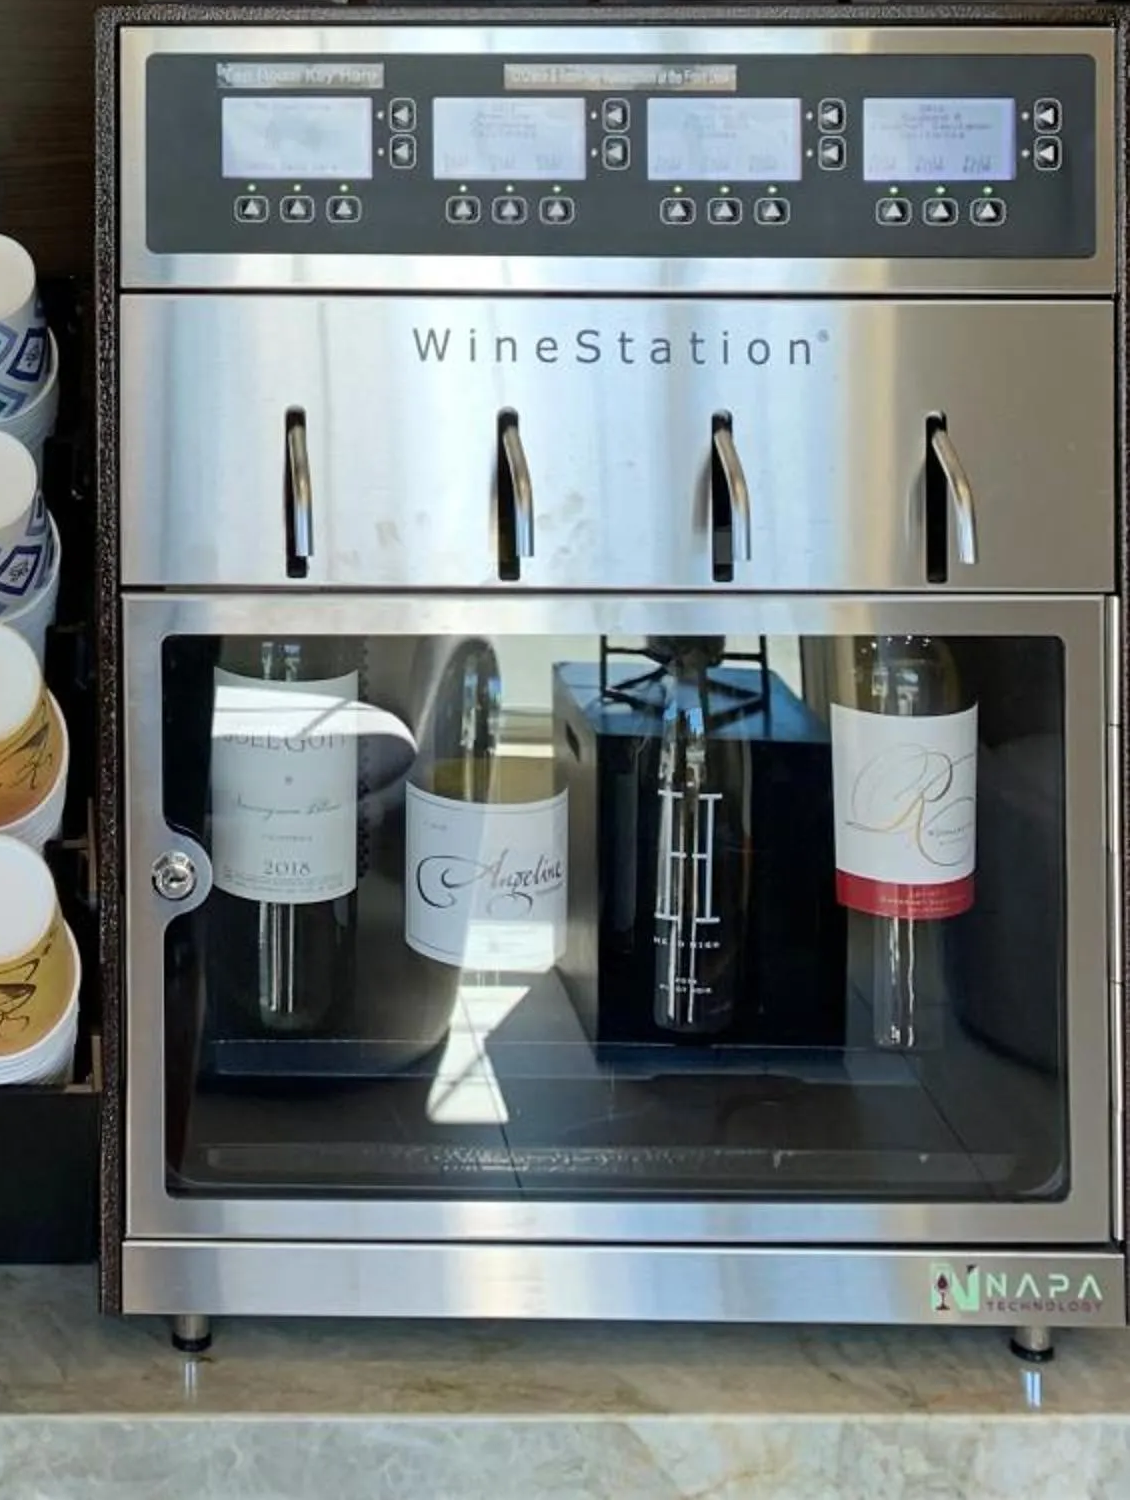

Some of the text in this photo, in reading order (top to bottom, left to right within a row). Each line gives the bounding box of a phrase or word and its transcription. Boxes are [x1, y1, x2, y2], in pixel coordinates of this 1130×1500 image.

[413, 328, 812, 365] WineStation
[263, 860, 311, 876] 2018
[653, 936, 685, 948] HED
[986, 1273, 1102, 1300] NAPA
[987, 1301, 1103, 1313] TECHNOLOGY
